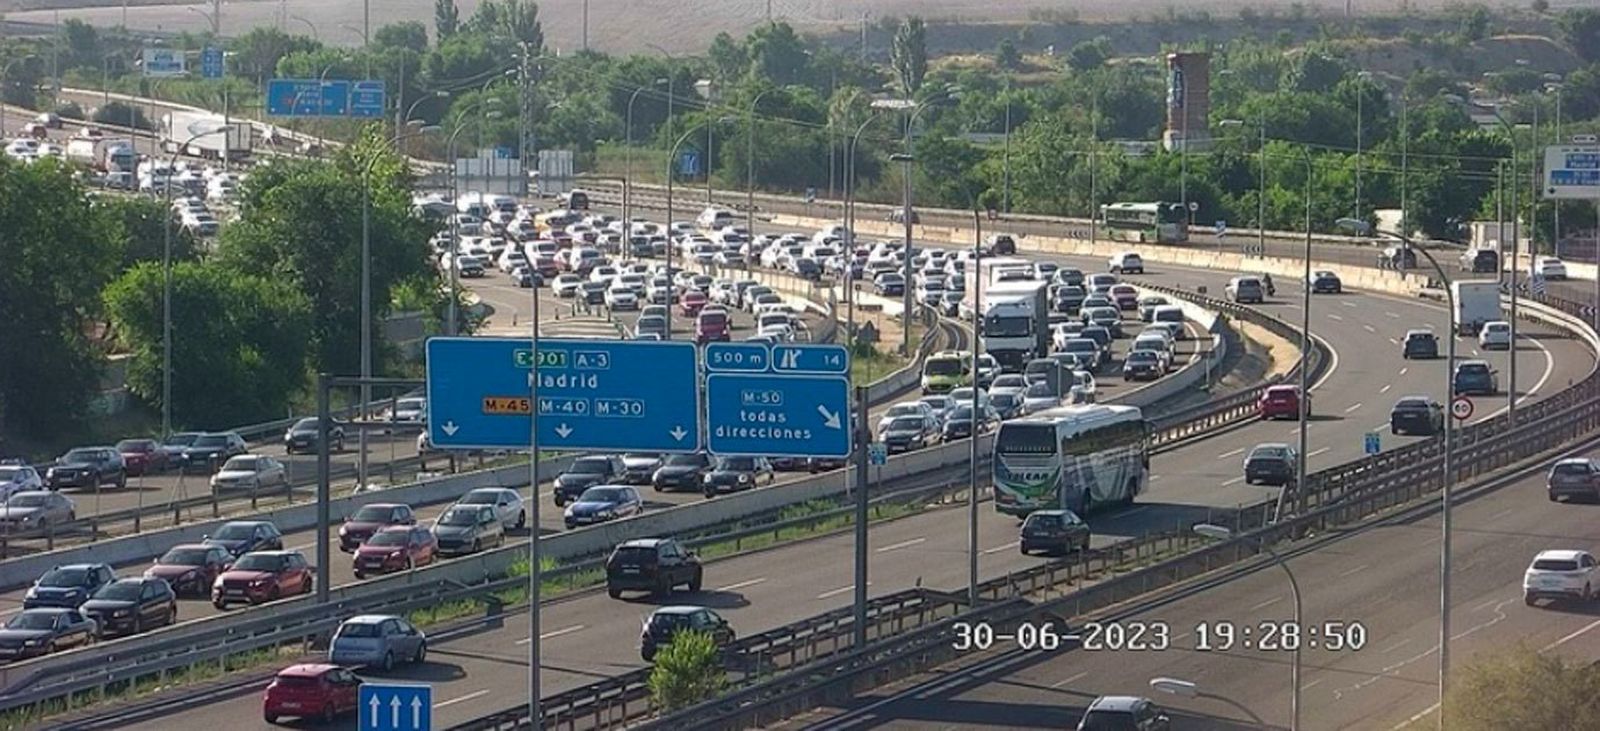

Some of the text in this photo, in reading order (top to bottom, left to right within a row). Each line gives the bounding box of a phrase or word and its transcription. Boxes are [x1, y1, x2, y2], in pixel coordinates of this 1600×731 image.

[577, 354, 608, 367] A-3
[714, 352, 761, 363] 500 m
[824, 354, 839, 365] 14
[527, 372, 598, 388] Madrid
[744, 391, 780, 403] M-50
[485, 400, 643, 415] M-45 M-40 M-30
[740, 410, 787, 423] todas
[715, 425, 812, 439] direcciones
